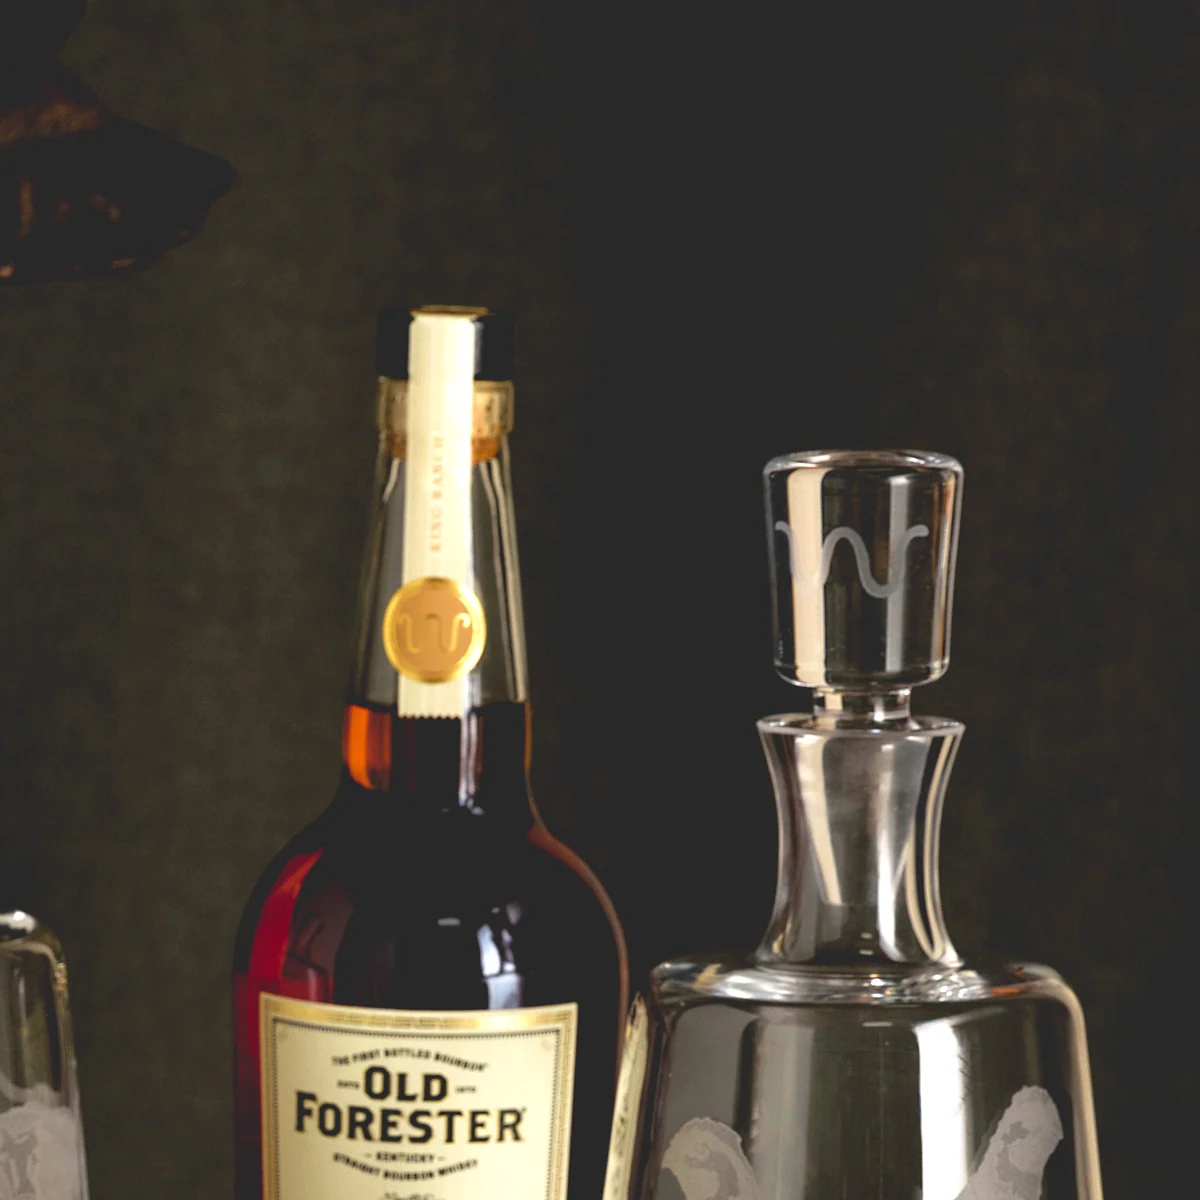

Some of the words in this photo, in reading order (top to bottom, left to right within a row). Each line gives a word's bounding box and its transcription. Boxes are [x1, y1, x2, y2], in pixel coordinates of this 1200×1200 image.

[331, 1055, 350, 1066] THE
[352, 1048, 380, 1062] FIRST
[384, 1046, 432, 1060] BOTTLED
[364, 1066, 448, 1102] OLD
[294, 1090, 524, 1143] FORESTER
[333, 1152, 381, 1176] STRAIGHT
[383, 1169, 435, 1181] BOURBON
[376, 1151, 435, 1163] KENTUCKY
